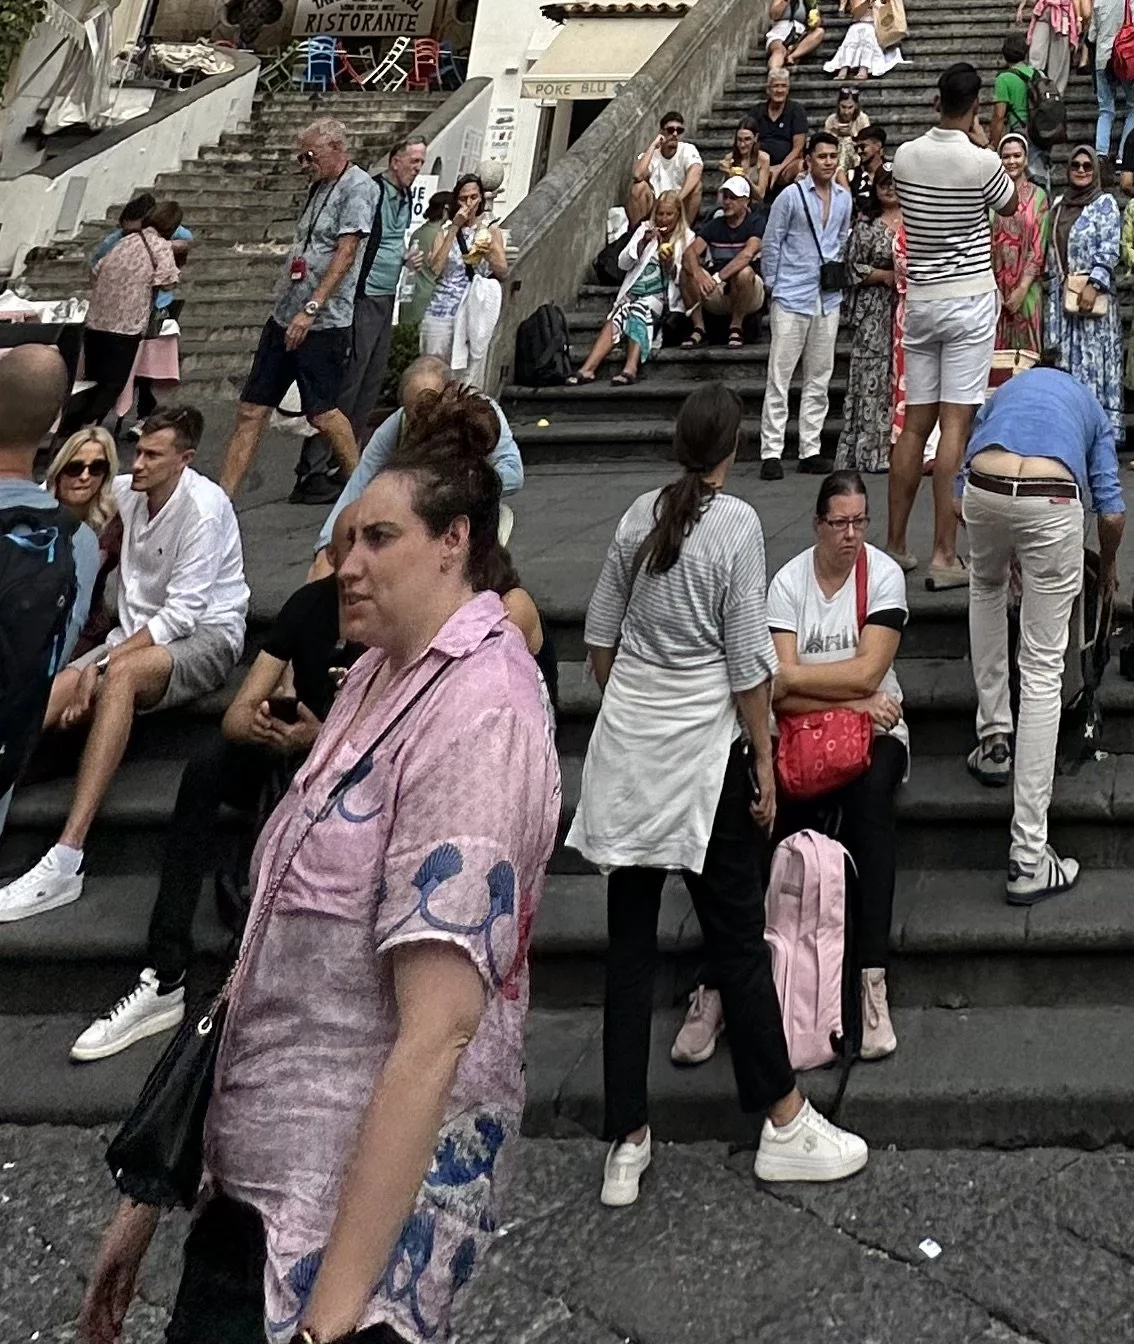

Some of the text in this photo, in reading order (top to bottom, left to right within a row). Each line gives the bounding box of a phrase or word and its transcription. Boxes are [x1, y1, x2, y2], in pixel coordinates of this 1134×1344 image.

[305, 13, 419, 32] RISTORANTE
[535, 82, 606, 95] POKE BLU
